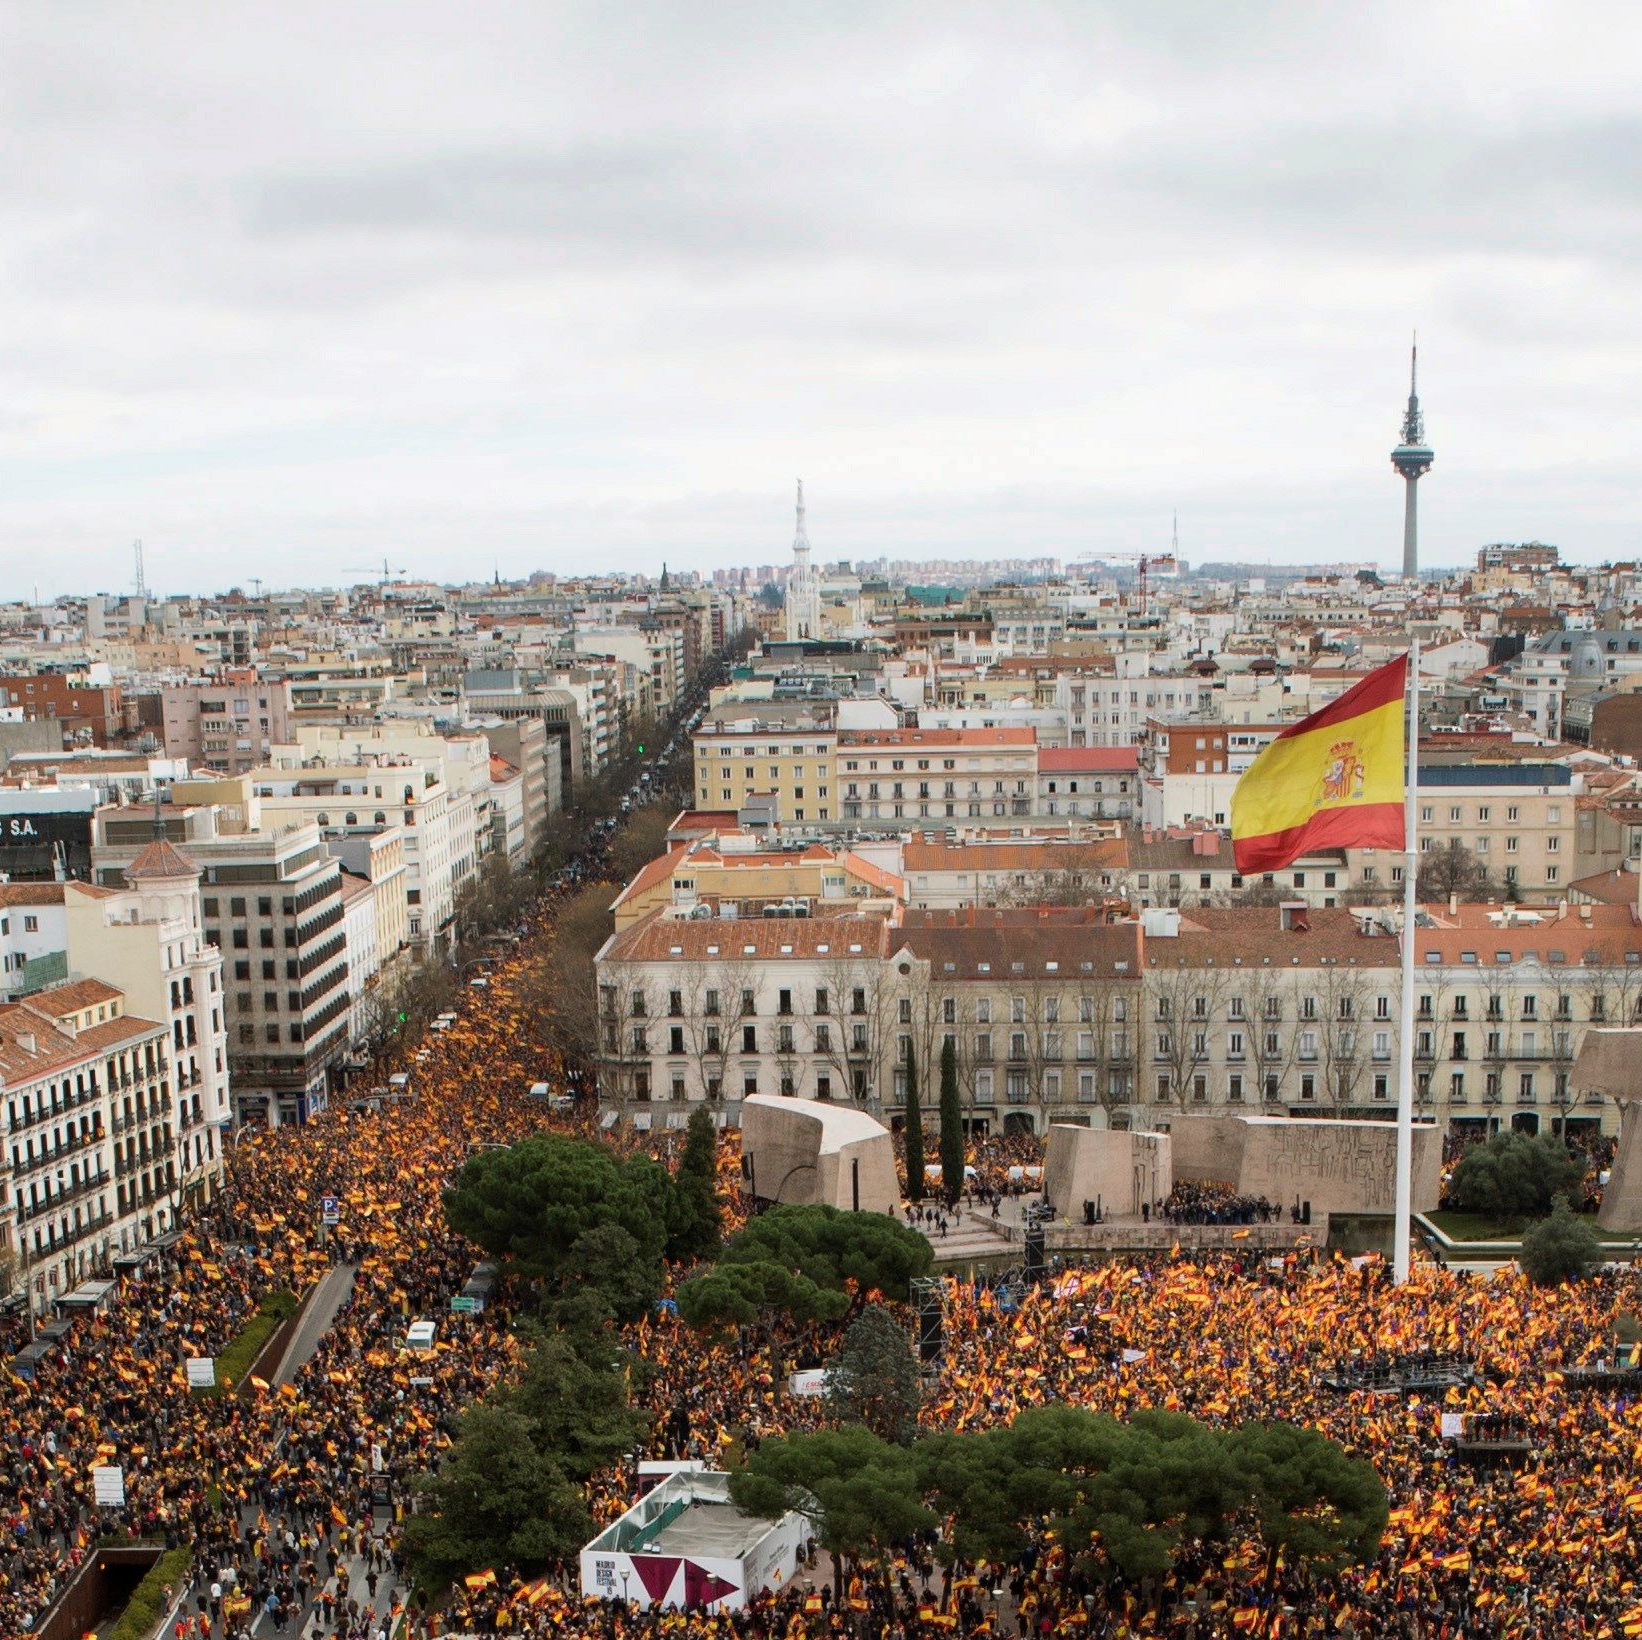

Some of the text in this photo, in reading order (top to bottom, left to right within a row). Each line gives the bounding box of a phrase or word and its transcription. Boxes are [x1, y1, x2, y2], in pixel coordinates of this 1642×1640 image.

[10, 818, 38, 836] S.A.
[595, 1560, 616, 1569] MADRID
[596, 1569, 613, 1578] DESIGN
[596, 1577, 617, 1587] FESTIVAL
